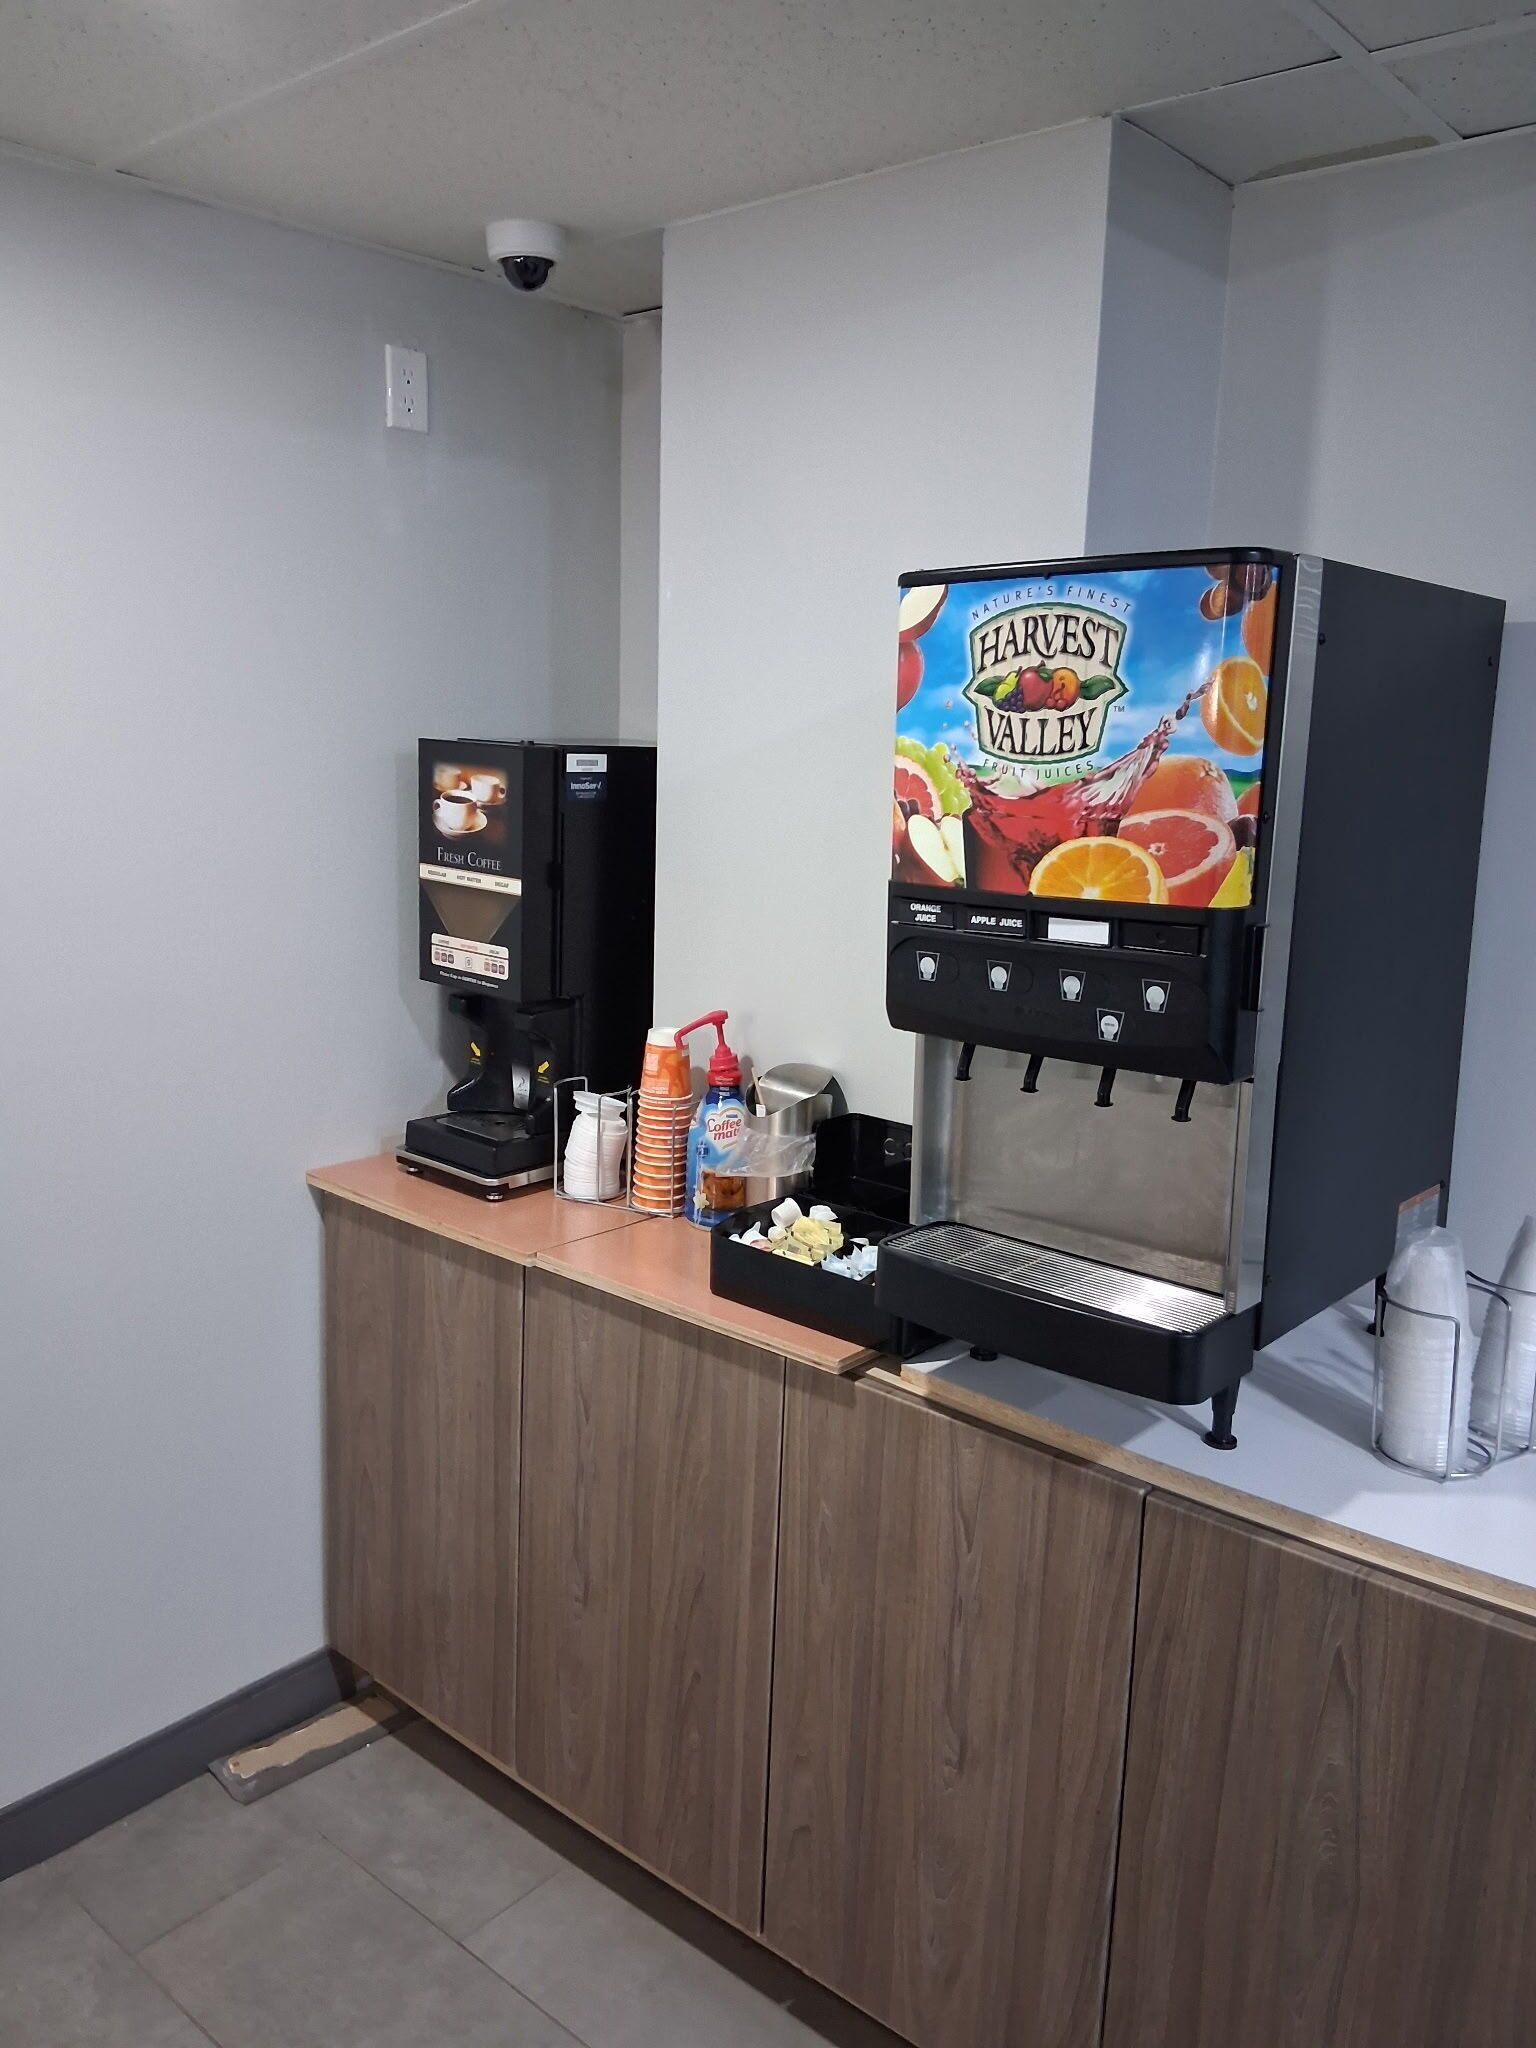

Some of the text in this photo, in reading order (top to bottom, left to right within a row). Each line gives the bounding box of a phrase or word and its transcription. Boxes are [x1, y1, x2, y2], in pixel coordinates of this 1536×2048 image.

[972, 585, 1132, 621] NATURE'S FINEST
[977, 613, 1120, 674] HARVEST
[984, 704, 1098, 756] VALLEY
[983, 758, 1094, 780] FRUIT JUICES
[910, 902, 942, 913] ORANGE
[914, 913, 937, 923] JUICE
[970, 915, 1023, 928] APPLE JUICE
[707, 1118, 742, 1133] Coffee
